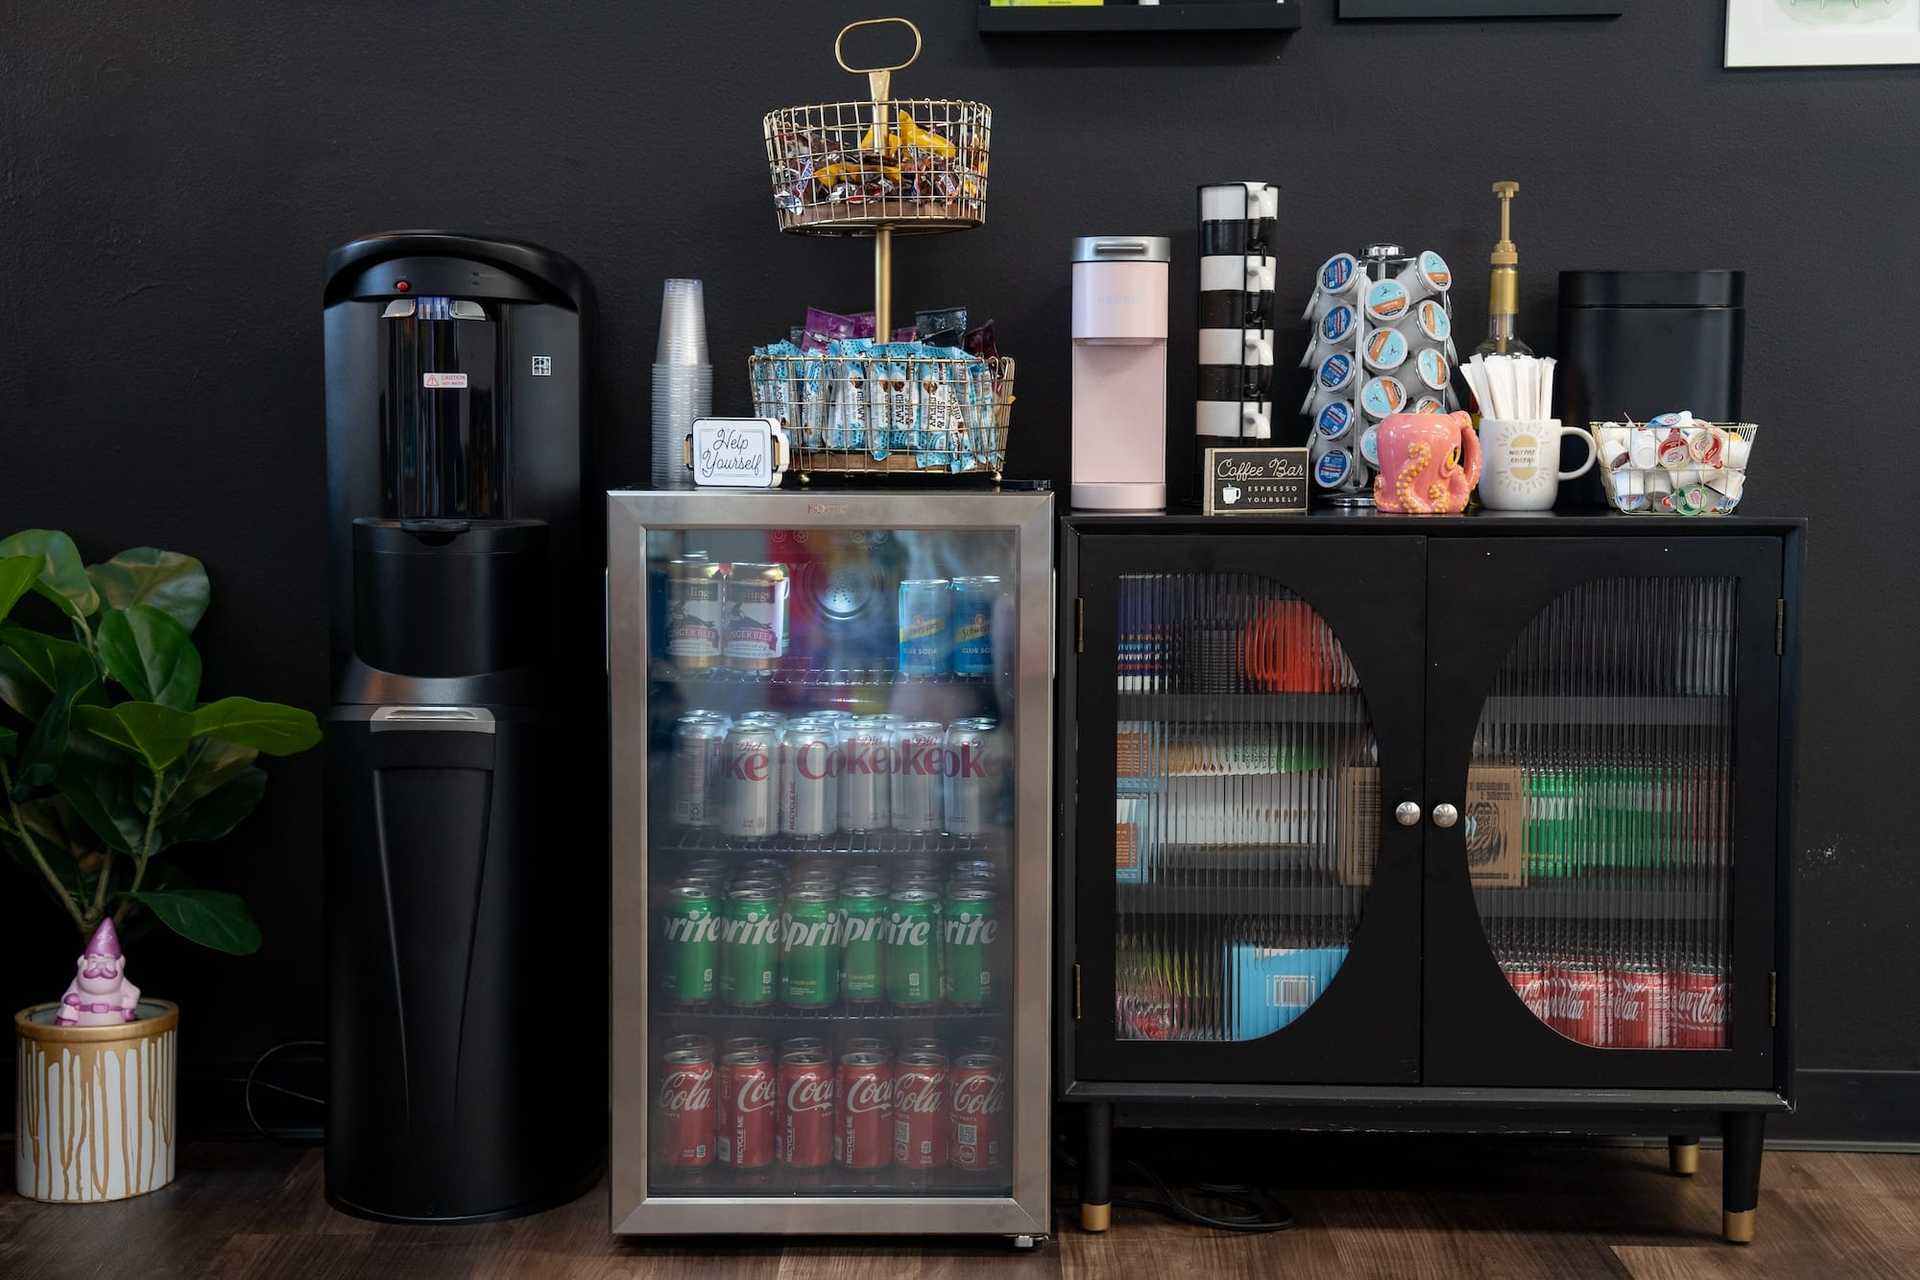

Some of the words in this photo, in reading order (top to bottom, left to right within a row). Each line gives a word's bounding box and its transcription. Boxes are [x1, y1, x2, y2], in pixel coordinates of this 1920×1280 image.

[896, 394, 905, 424] CHEWY
[712, 428, 749, 455] Help
[702, 448, 761, 478] Yourself
[1217, 458, 1264, 481] Coffee
[1268, 458, 1304, 477] Bar
[721, 753, 769, 781] ke
